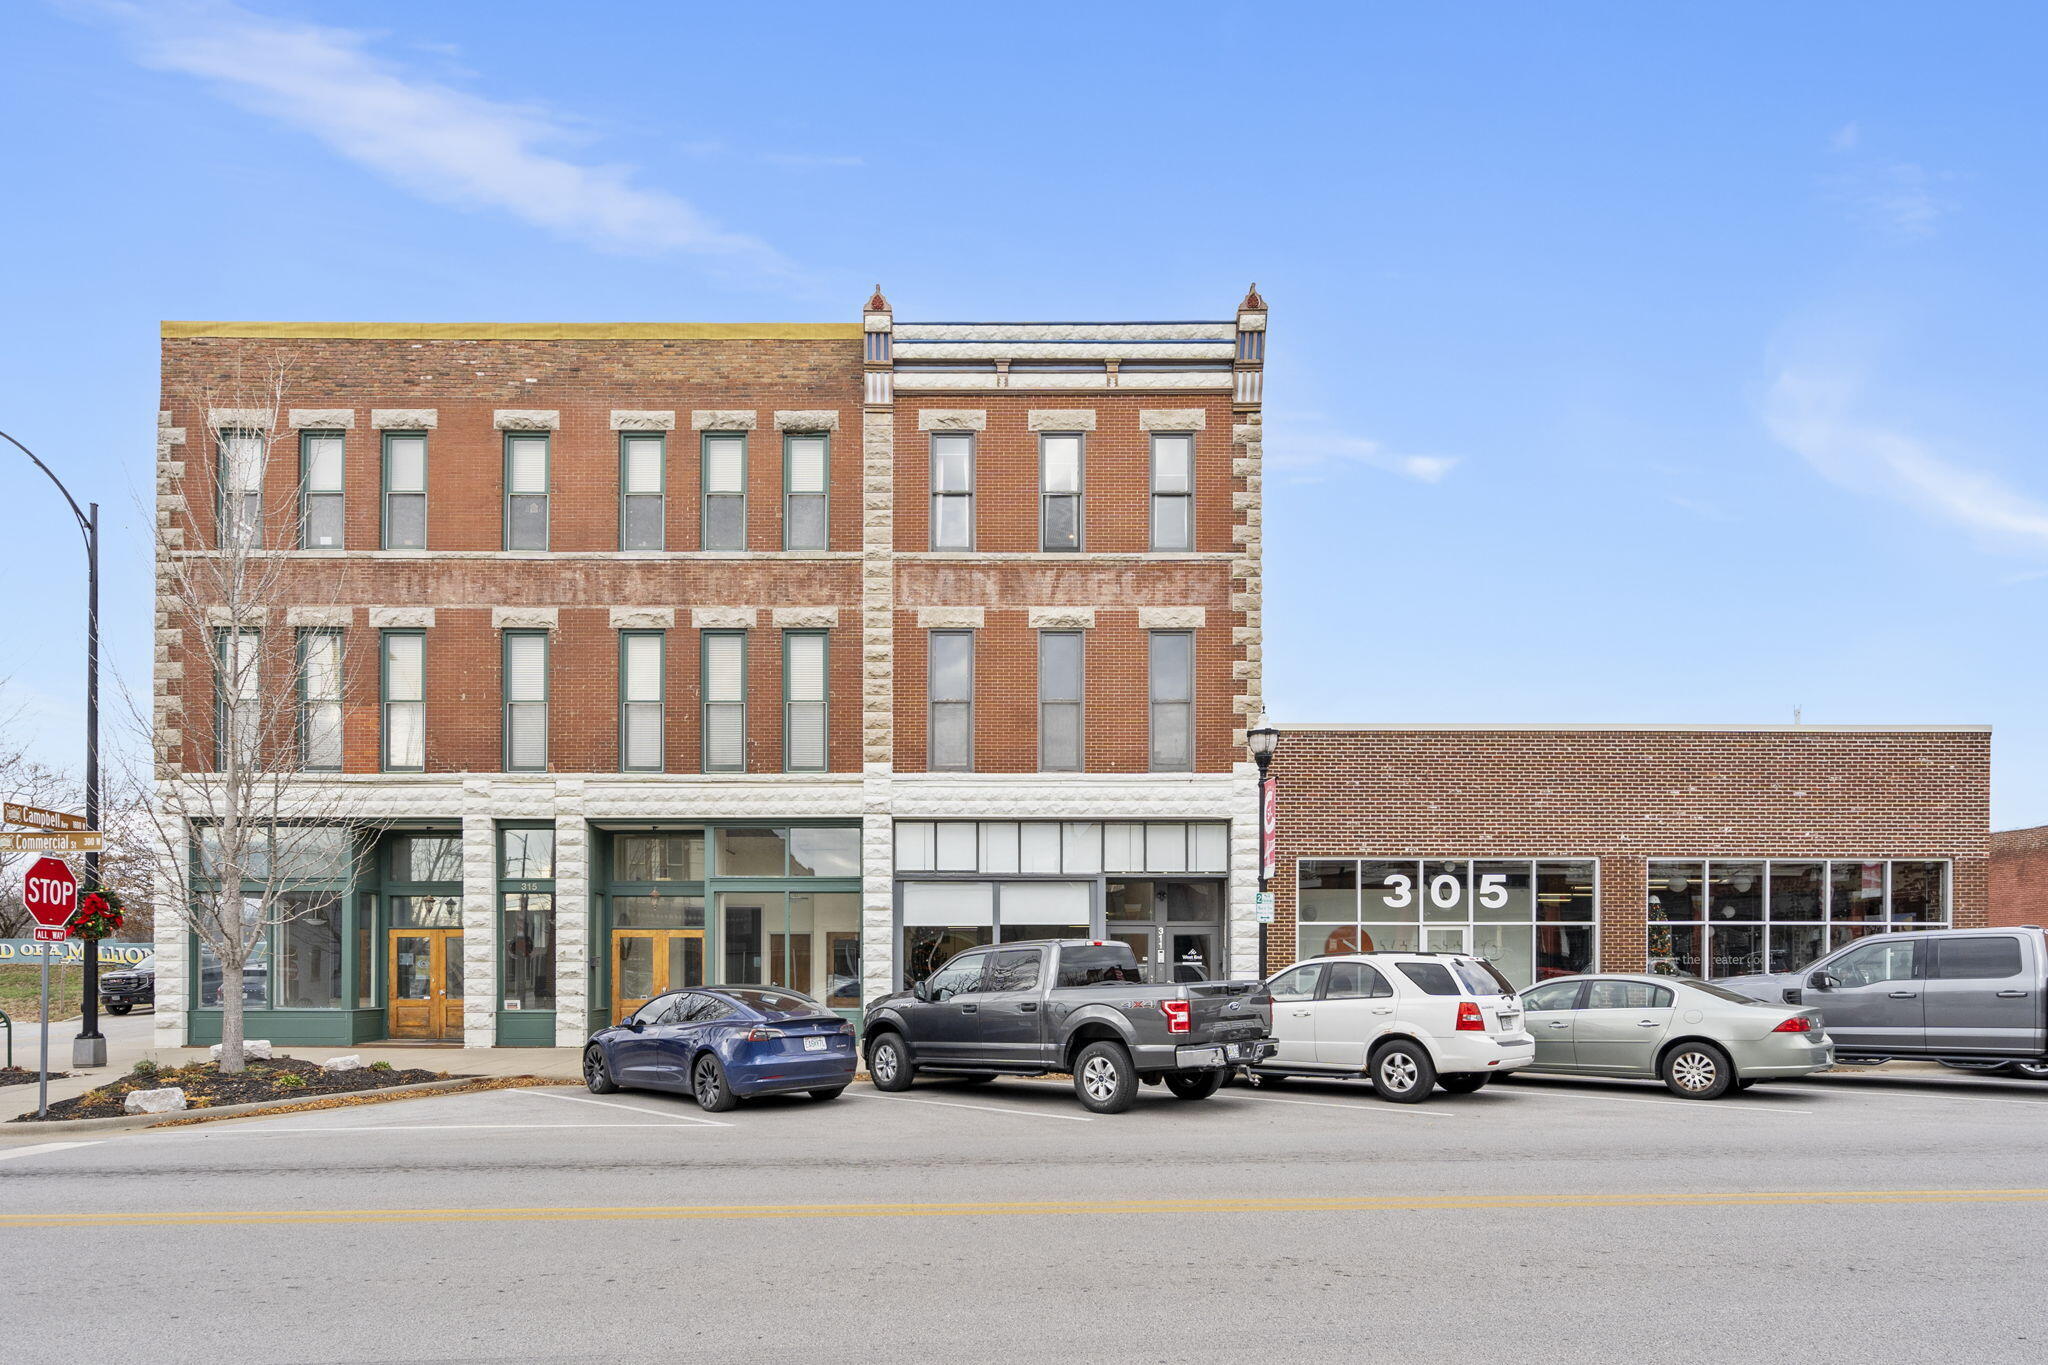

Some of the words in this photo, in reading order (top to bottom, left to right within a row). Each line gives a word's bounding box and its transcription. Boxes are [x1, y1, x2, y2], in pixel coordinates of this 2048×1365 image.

[23, 806, 60, 828] Campbell
[16, 834, 69, 849] Commercial
[28, 877, 74, 906] STOP
[521, 883, 538, 891] 315
[1382, 873, 1509, 908] 305
[37, 930, 49, 939] ALL
[52, 930, 64, 940] WAY
[64, 942, 155, 964] MLLIO
[1682, 952, 1701, 965] the
[1711, 953, 1745, 965] reater
[1746, 952, 1777, 968] go.
